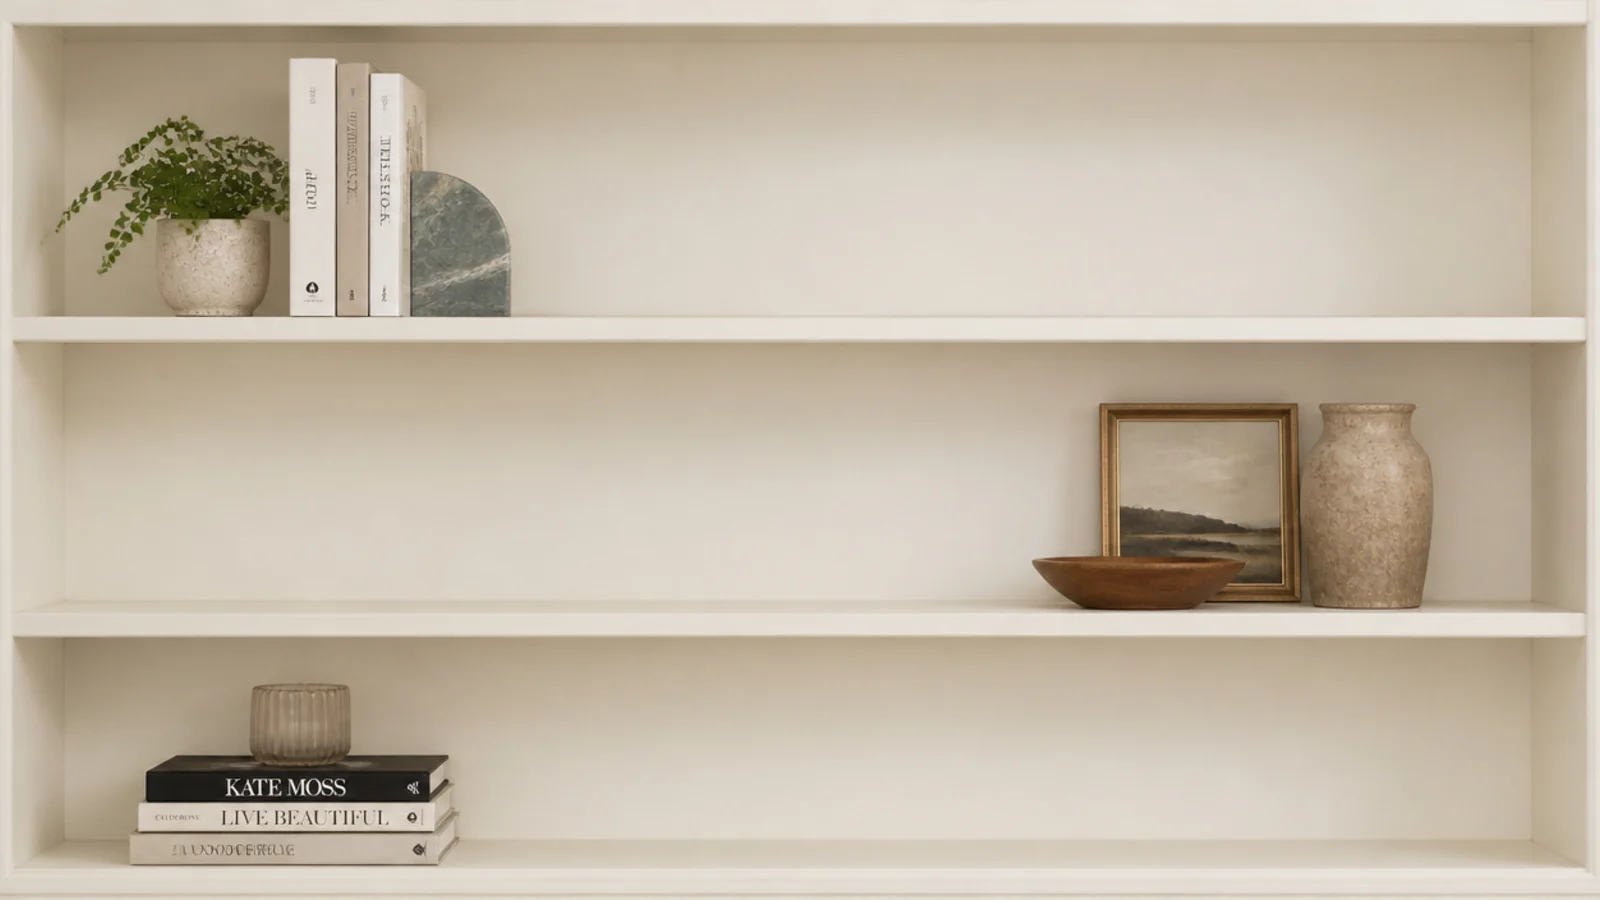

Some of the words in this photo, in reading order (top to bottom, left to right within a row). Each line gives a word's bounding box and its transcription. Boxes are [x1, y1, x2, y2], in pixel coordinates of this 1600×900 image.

[225, 778, 282, 797] KATE
[287, 778, 347, 797] MOSS
[221, 809, 268, 826] LIVE
[274, 809, 389, 826] BEAUTIFUL
